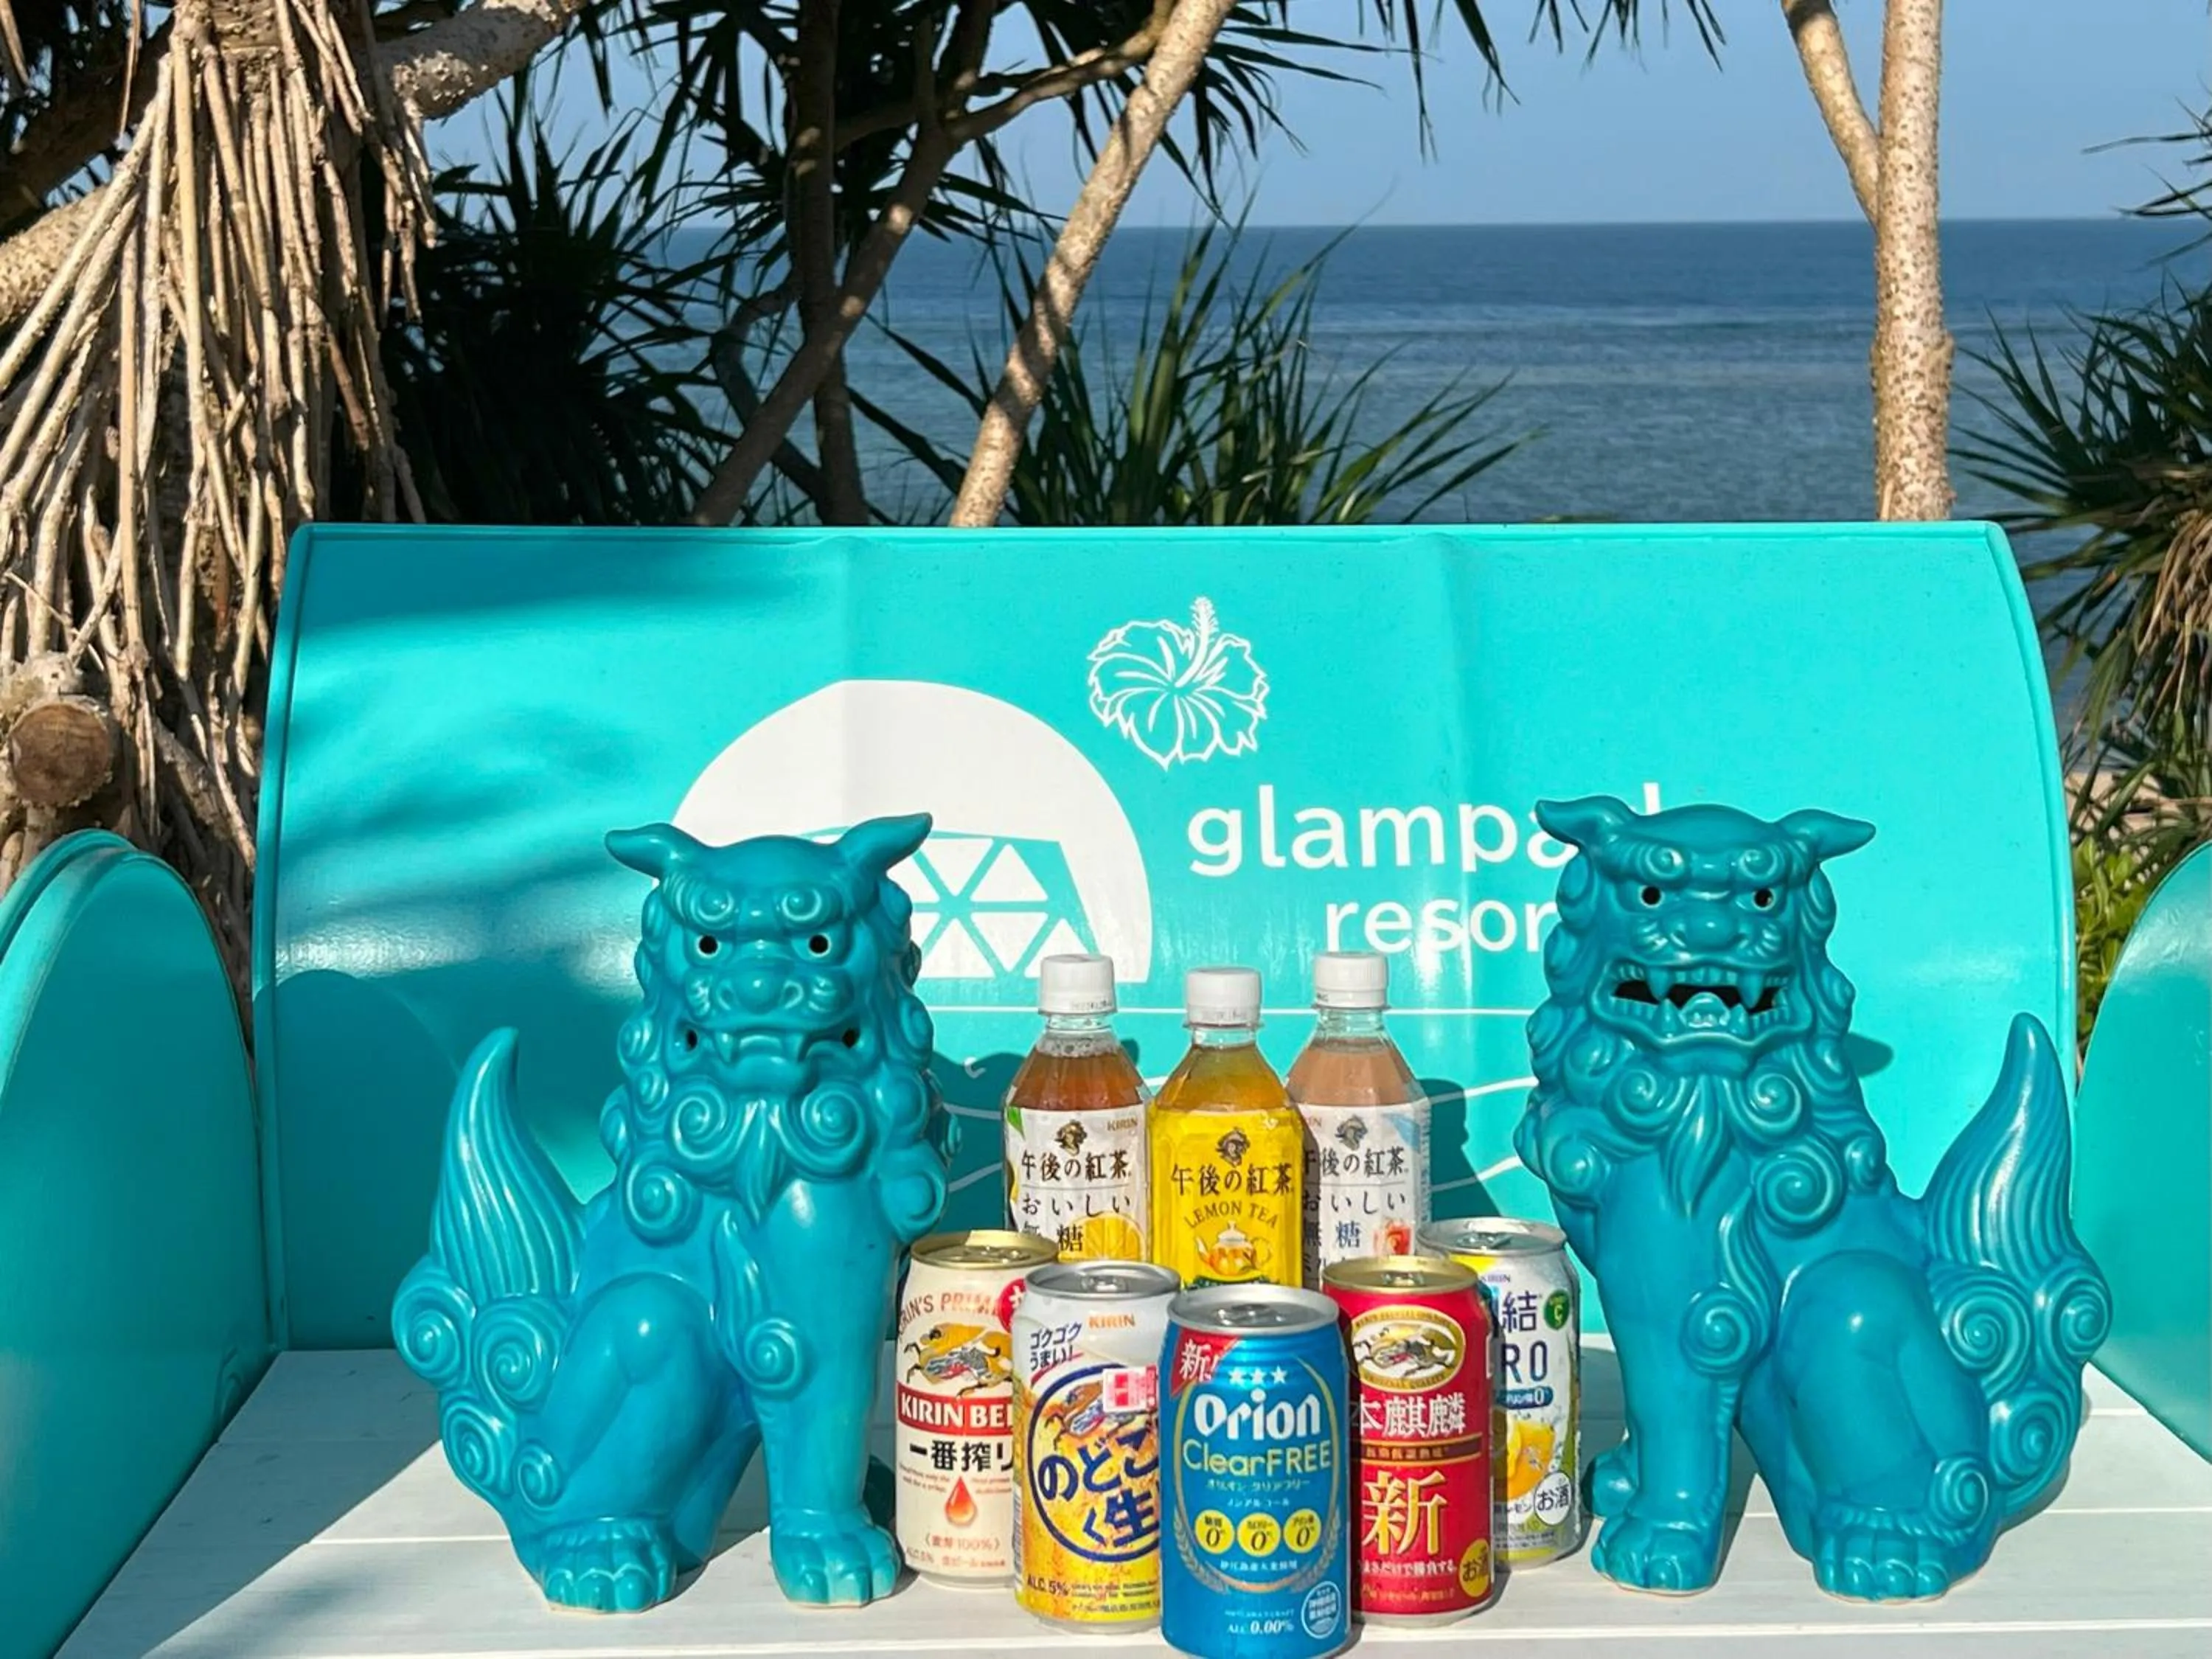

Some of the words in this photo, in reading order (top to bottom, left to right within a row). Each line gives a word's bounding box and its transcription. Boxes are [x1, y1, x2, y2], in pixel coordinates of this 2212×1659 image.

[1327, 894, 1558, 953] resor
[1107, 1119, 1138, 1132] KIRIN
[1021, 1150, 1129, 1182] 午後の紅茶
[1171, 1163, 1293, 1197] 午後の紅茶
[1022, 1193, 1130, 1218] おいしい
[1183, 1200, 1243, 1230] LEMON
[1250, 1204, 1279, 1230] TEA
[1030, 1321, 1083, 1350] ゴクゴク
[1088, 1313, 1136, 1329] KIRIN
[900, 1392, 964, 1428] KIRIN
[1194, 1388, 1321, 1441] Orion
[909, 1439, 1015, 1473] 一番搾り
[1182, 1439, 1332, 1478] ClearFREE
[1360, 1470, 1448, 1556] 新
[1537, 1485, 1571, 1512] お酒
